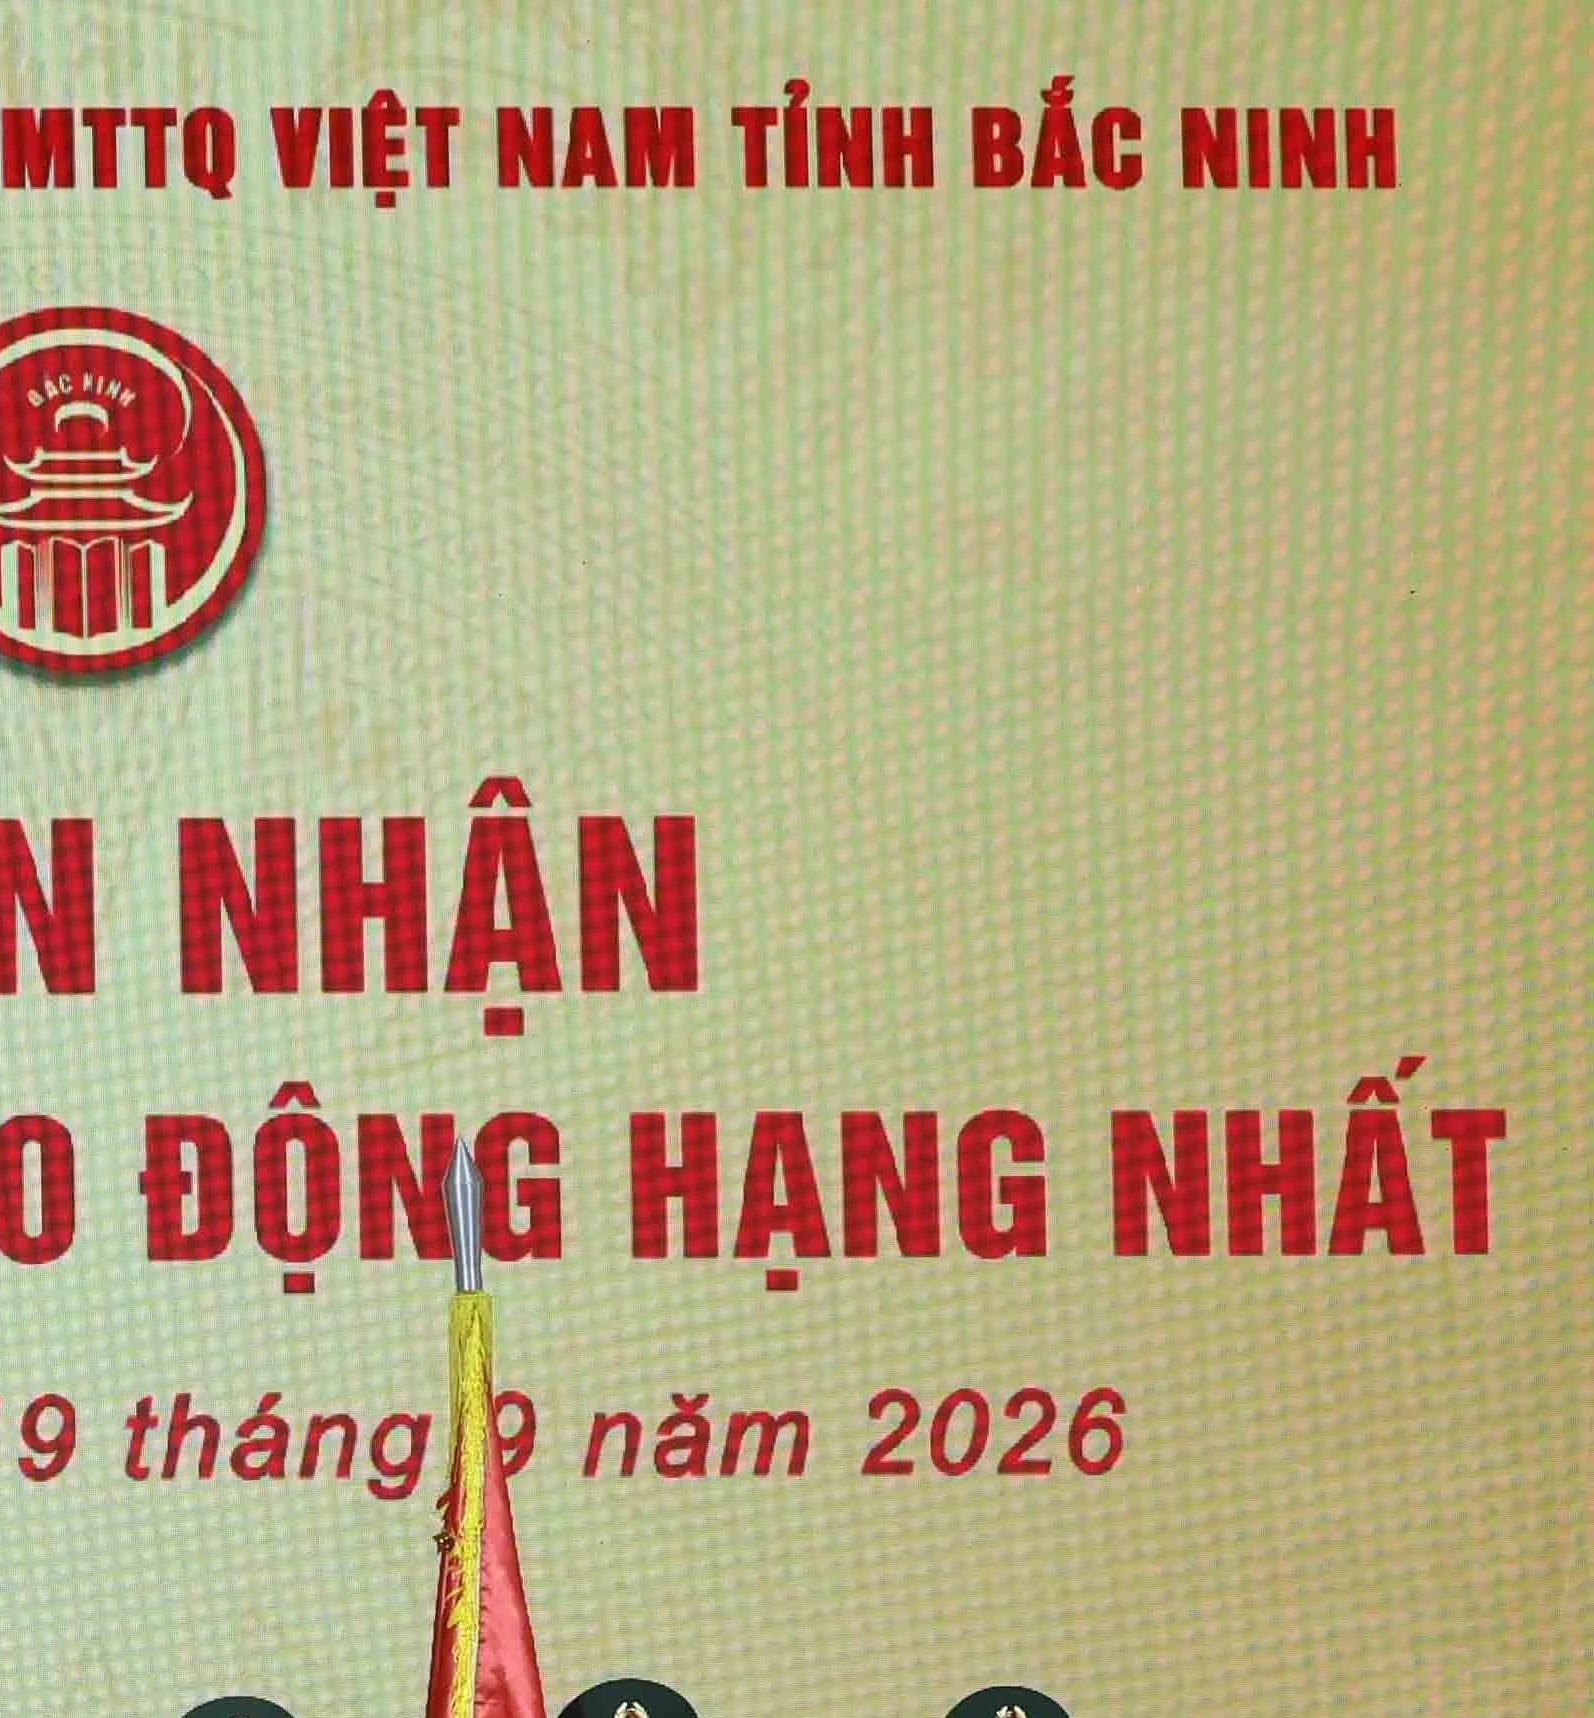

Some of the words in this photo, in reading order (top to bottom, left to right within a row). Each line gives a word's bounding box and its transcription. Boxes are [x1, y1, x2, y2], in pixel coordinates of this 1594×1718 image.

[270, 88, 461, 209] VIỆT
[498, 106, 697, 189] NAM
[732, 78, 936, 189] TỈNH
[971, 75, 1144, 190] BẮC
[1181, 107, 1397, 190] NINH
[178, 775, 699, 1037] NHẬN
[139, 1081, 563, 1294] ĐỘNG
[629, 1109, 1047, 1292] HẠNG
[1111, 1055, 1508, 1257] NHẤT
[123, 1392, 434, 1500] tháng
[583, 1394, 812, 1479] năm
[860, 1386, 1129, 1477] 2026
